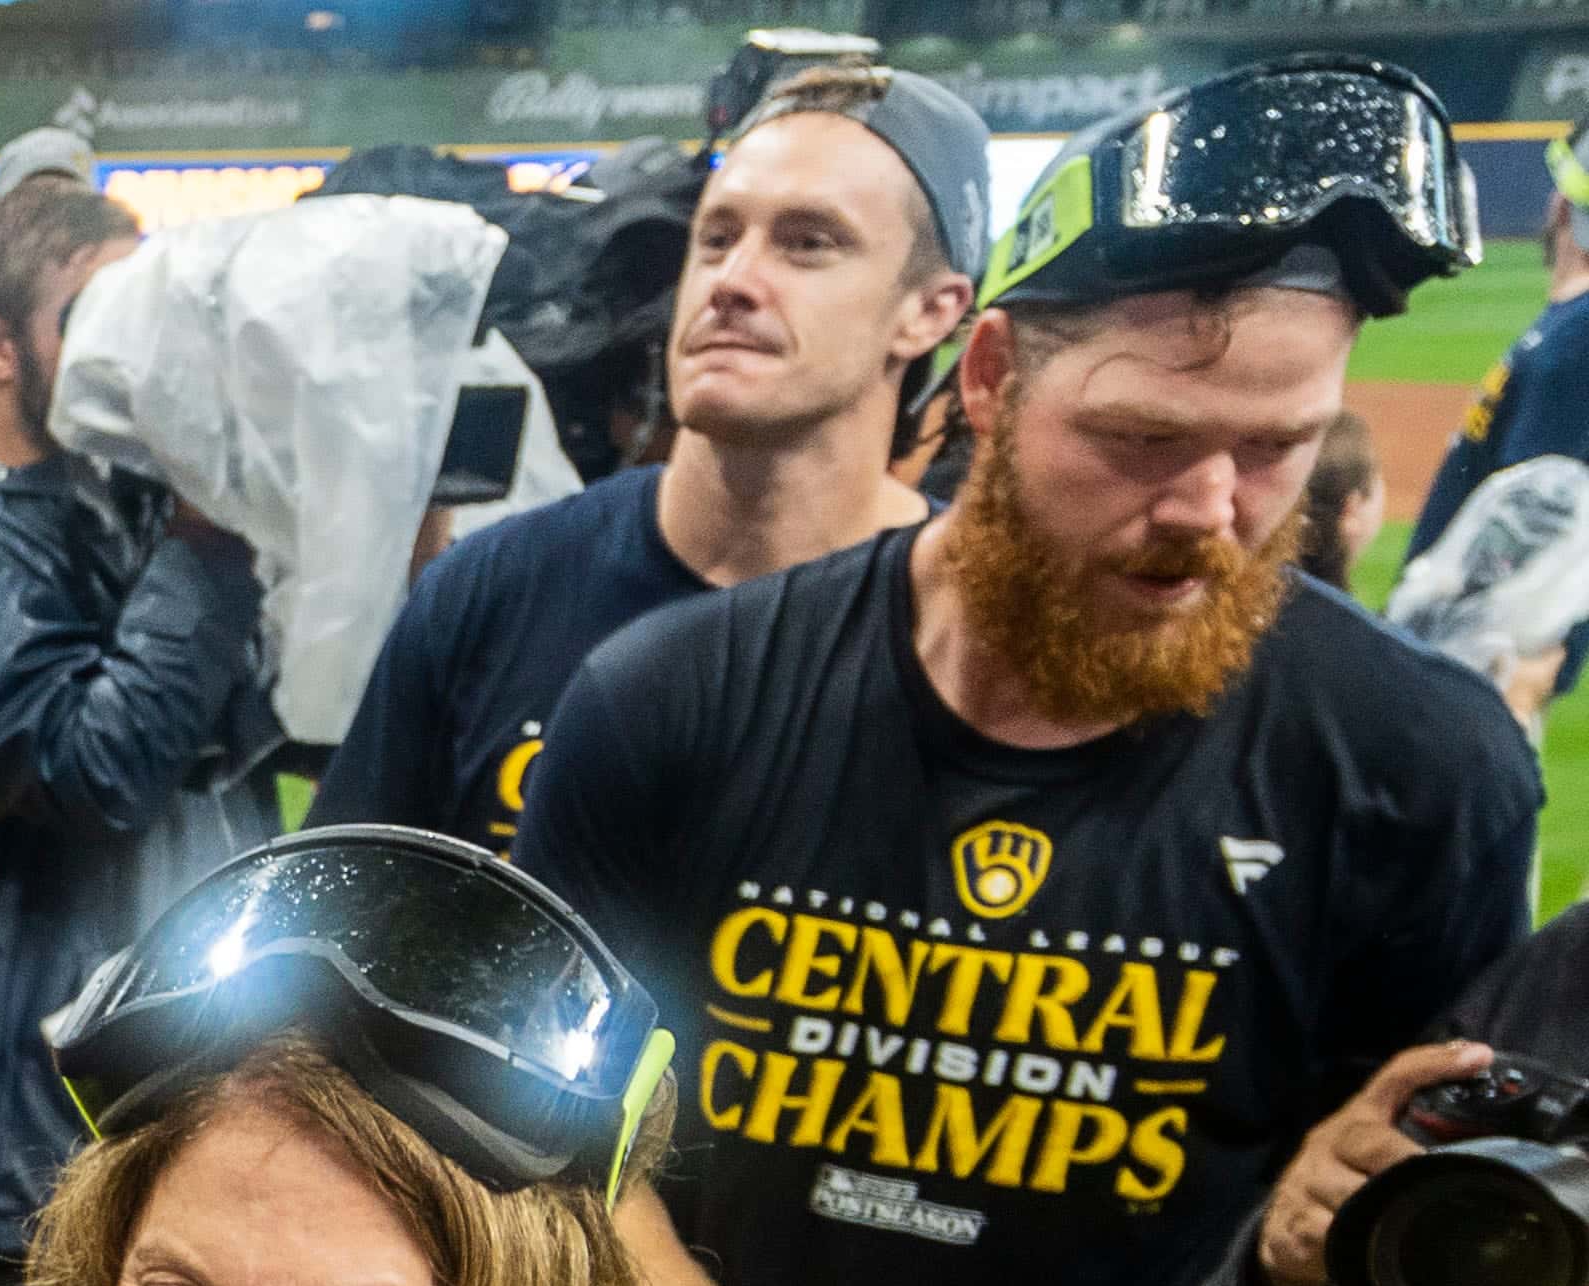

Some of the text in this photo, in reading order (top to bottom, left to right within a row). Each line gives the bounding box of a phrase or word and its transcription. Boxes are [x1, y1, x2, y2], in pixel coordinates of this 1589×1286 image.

[710, 906, 1227, 1064] CENTRAL
[737, 880, 1241, 968] NATIONAL LEAGUE
[787, 1015, 1118, 1101] DIVISION
[699, 1039, 1189, 1201] CHAMPS
